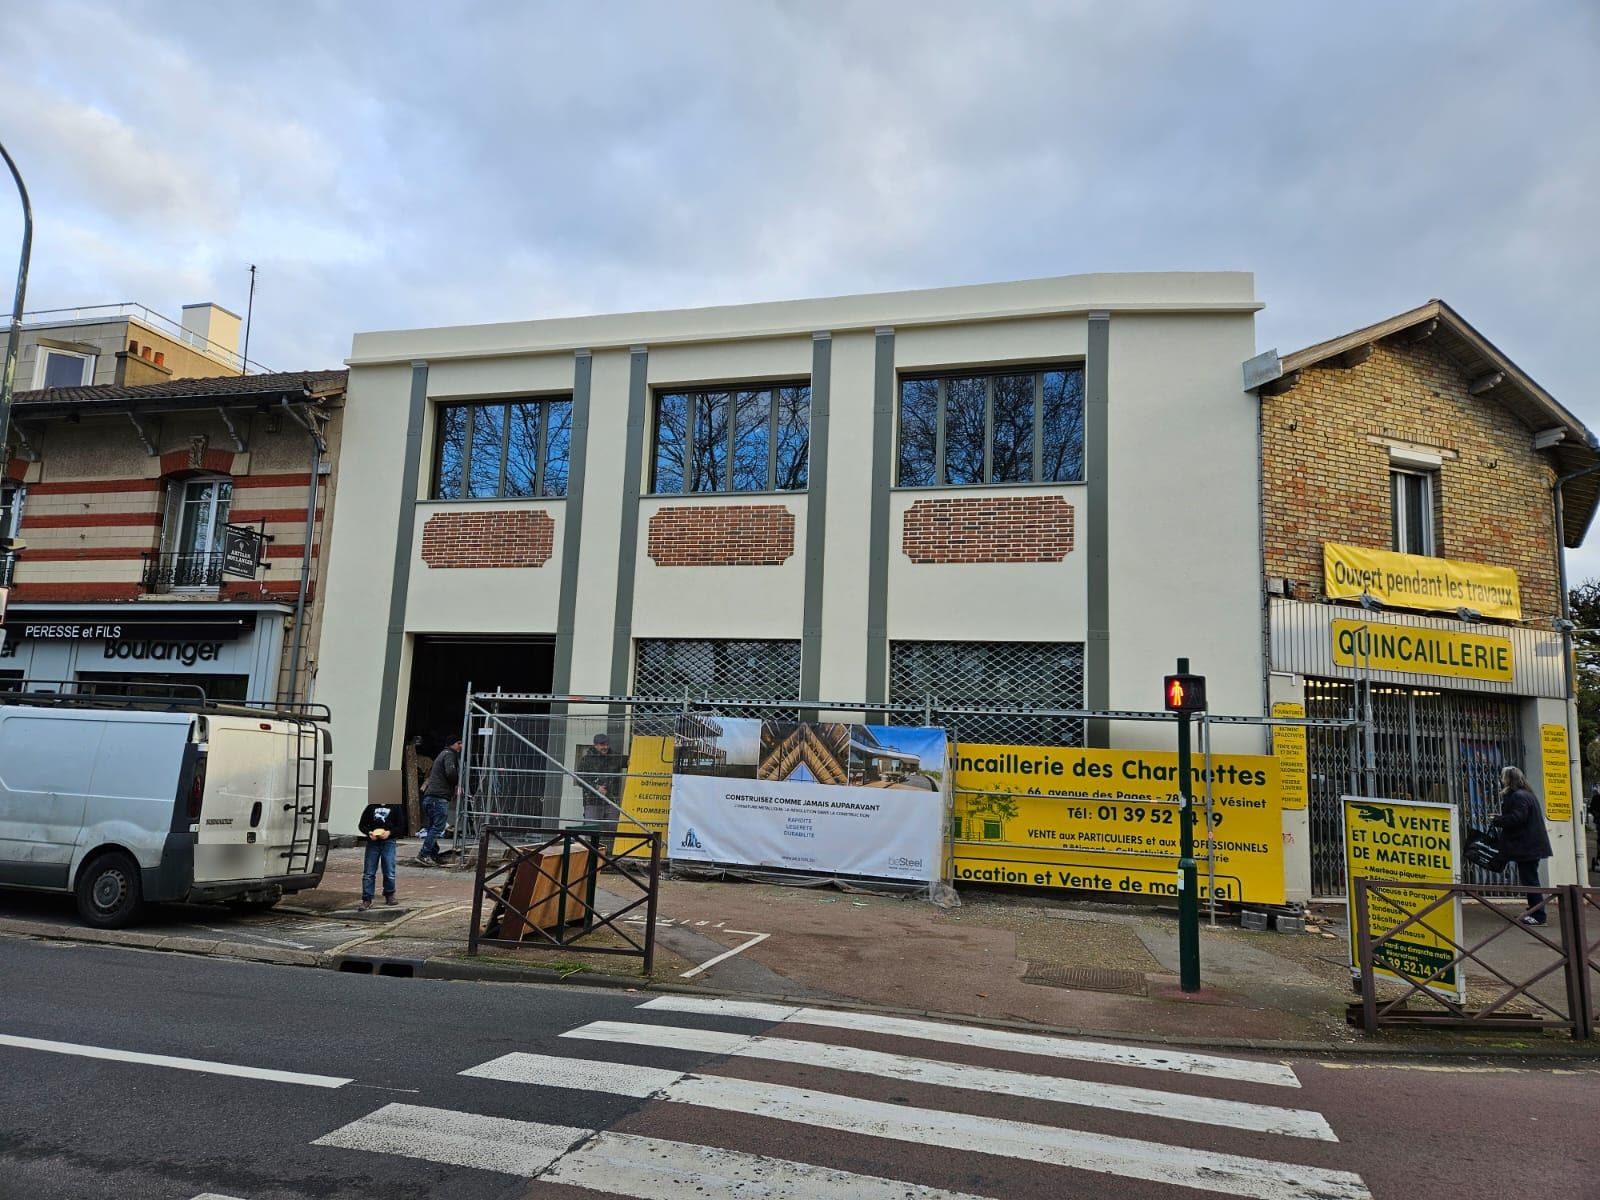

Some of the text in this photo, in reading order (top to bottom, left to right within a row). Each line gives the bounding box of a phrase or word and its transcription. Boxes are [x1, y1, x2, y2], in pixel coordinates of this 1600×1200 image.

[1335, 561, 1513, 606] Ouvert pendant les travaux
[25, 626, 121, 638] PERESSE et FILS
[104, 640, 224, 666] Boulanger
[1339, 629, 1509, 671] QUINCAILLERIE
[949, 753, 1063, 776] incaillerie
[1073, 757, 1113, 779] des
[638, 793, 672, 801] ELECTRICIT
[725, 793, 880, 812] CONSTRUISEZ COMME JAMAIS AUPARAVANT
[1092, 789, 1112, 799] des
[1220, 796, 1267, 810] Vésinet
[1098, 806, 1117, 821] 01
[1123, 807, 1146, 823] 39
[1150, 809, 1173, 825] 52
[1399, 815, 1450, 833] VENTE
[1028, 829, 1268, 854] VENTE aux PARTICULIERS et aux OFESSIONNELS
[1352, 829, 1450, 851] ET LOCATION
[1353, 846, 1451, 869] DE MATERIEL
[954, 864, 1232, 900] Location et Vente de marel
[1369, 866, 1397, 875] Marteau
[1399, 869, 1426, 879] piqueur
[1409, 890, 1438, 901] Parquet
